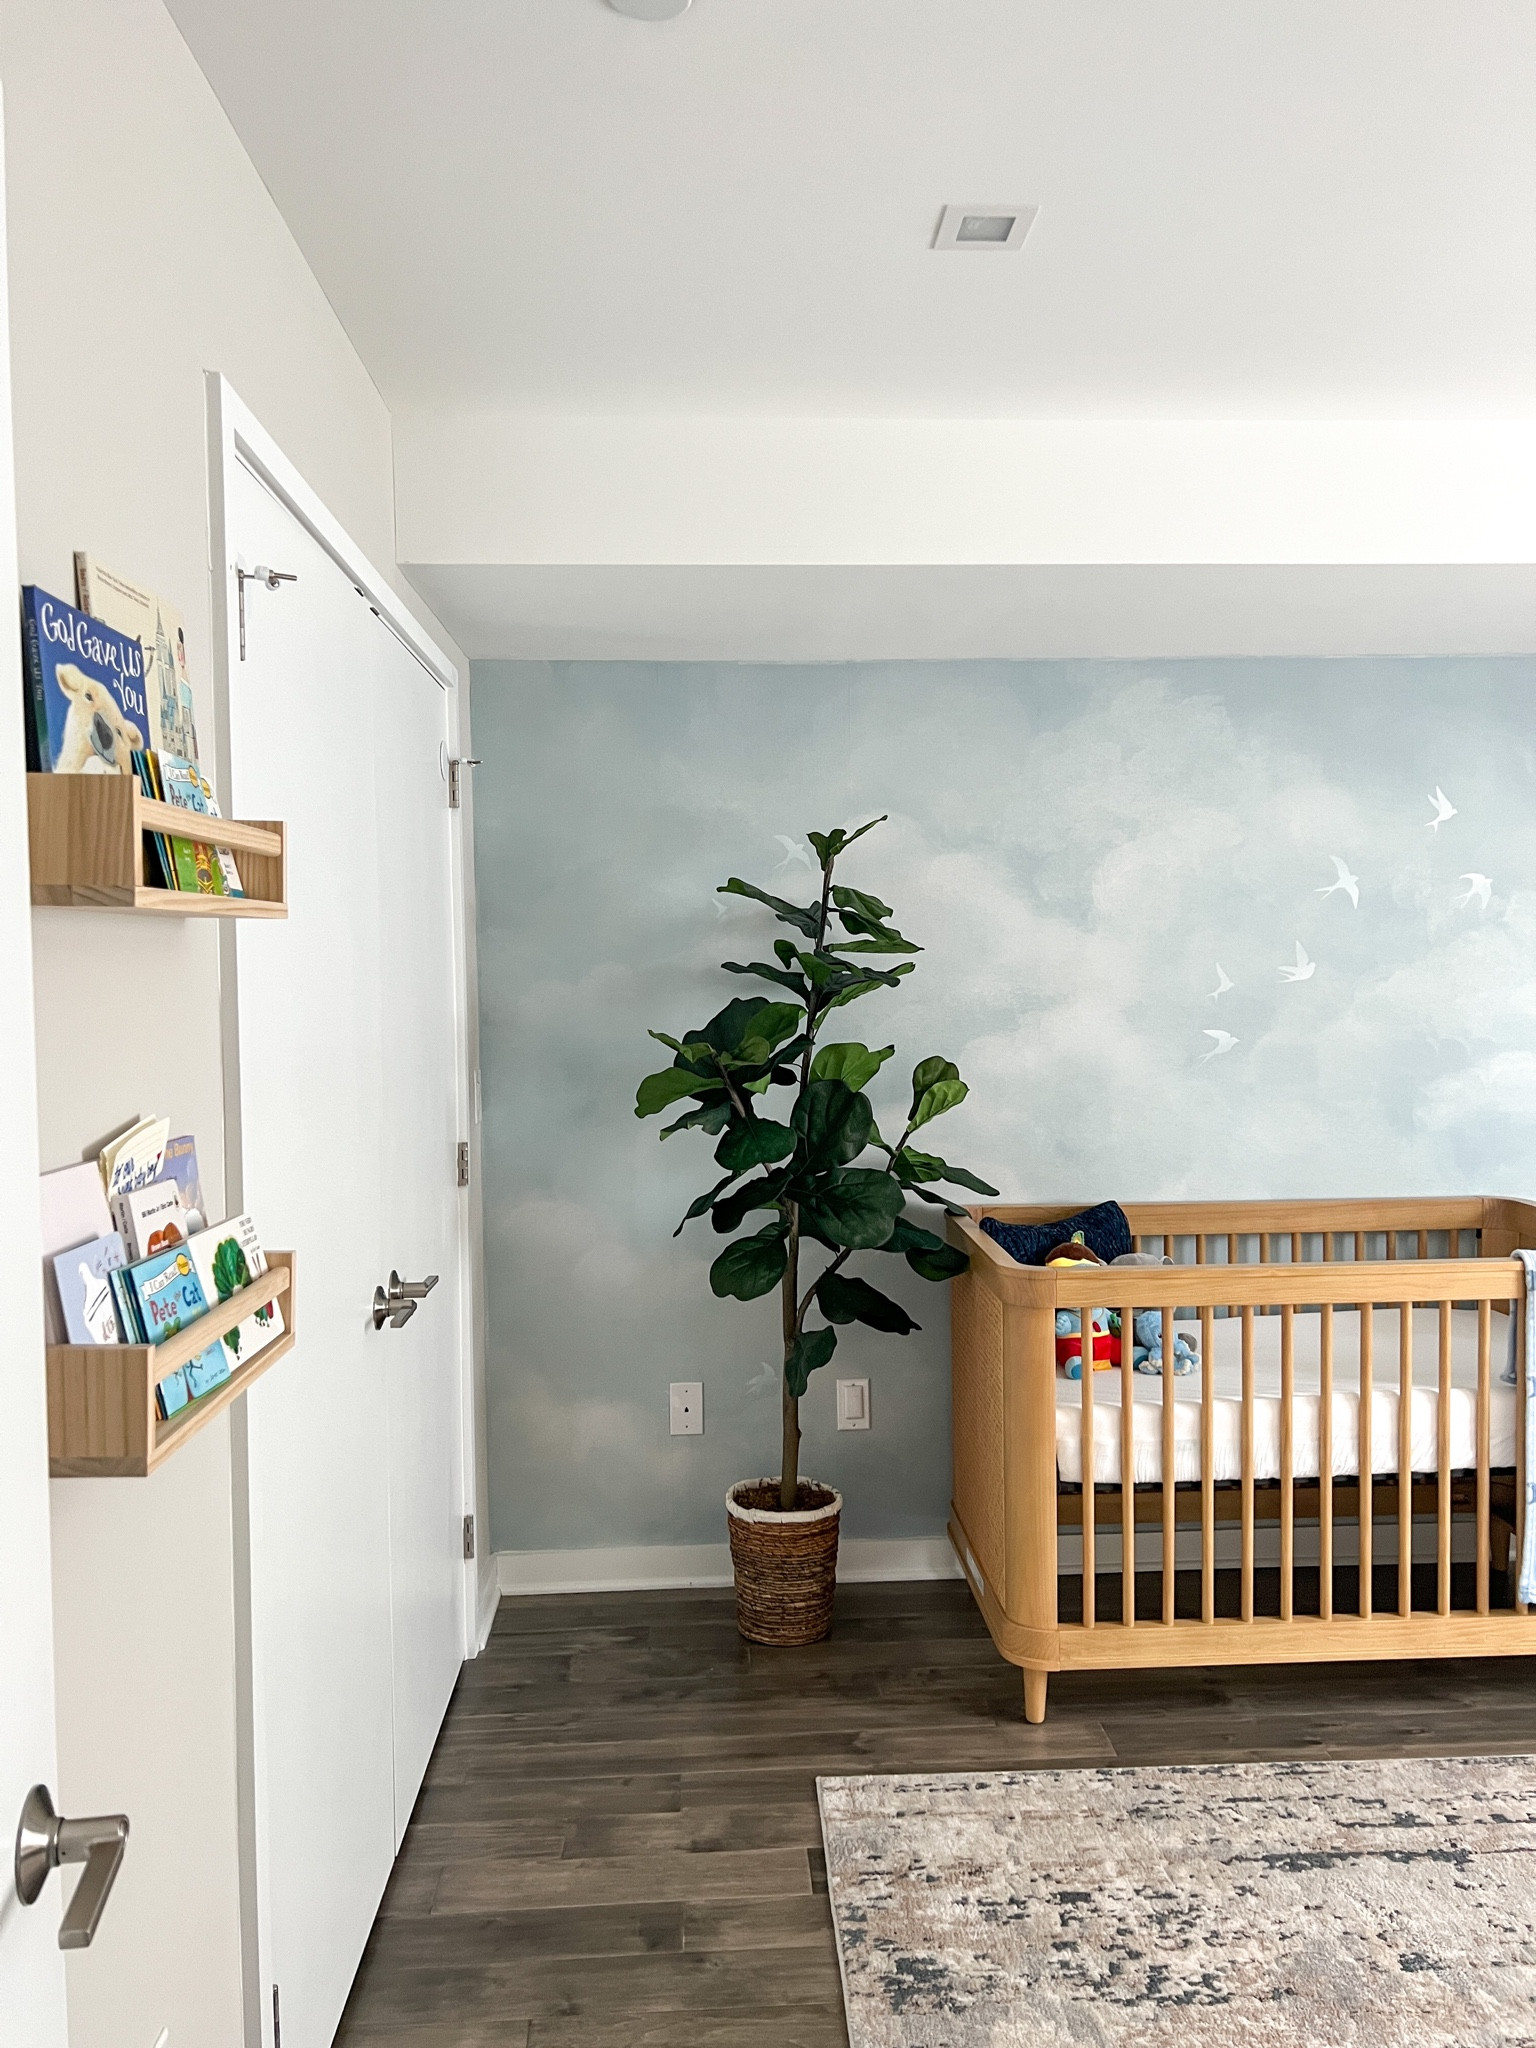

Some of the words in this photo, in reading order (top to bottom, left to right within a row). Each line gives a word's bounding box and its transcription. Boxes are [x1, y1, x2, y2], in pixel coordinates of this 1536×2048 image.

[41, 602, 76, 652] God
[76, 621, 121, 672] Gave
[113, 672, 145, 716] You
[168, 783, 188, 809] Pete
[149, 1297, 178, 1326] Pete
[182, 1282, 202, 1308] Cat
[153, 1278, 165, 1290] Can
